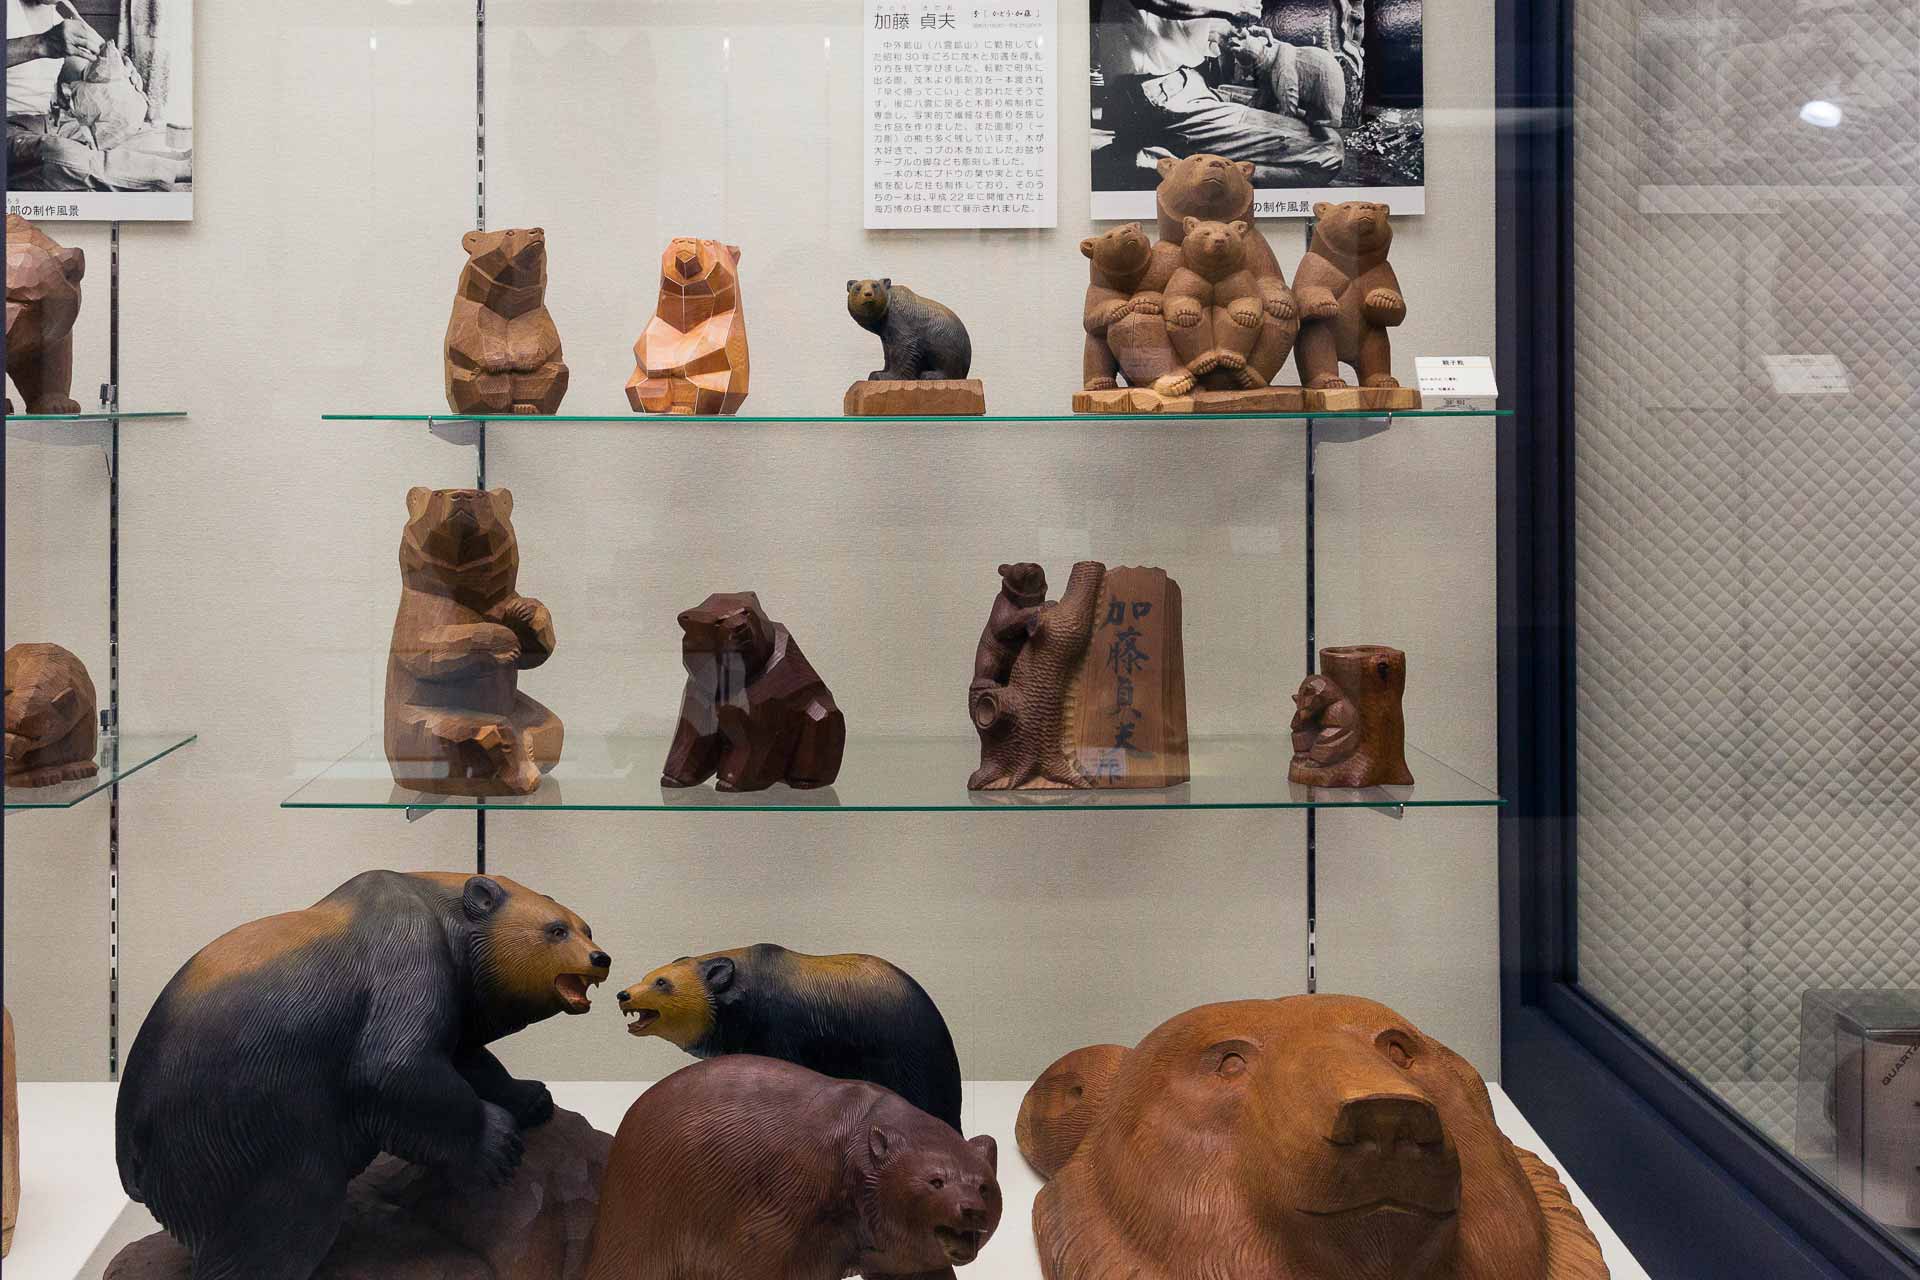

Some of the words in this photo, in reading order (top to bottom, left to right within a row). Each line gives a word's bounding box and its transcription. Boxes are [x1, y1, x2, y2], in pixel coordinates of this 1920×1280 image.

[874, 13, 910, 30] 加藤
[919, 13, 956, 30] 貞夫
[5, 205, 80, 217] 郎の制作風景
[1254, 201, 1310, 213] の制作風景
